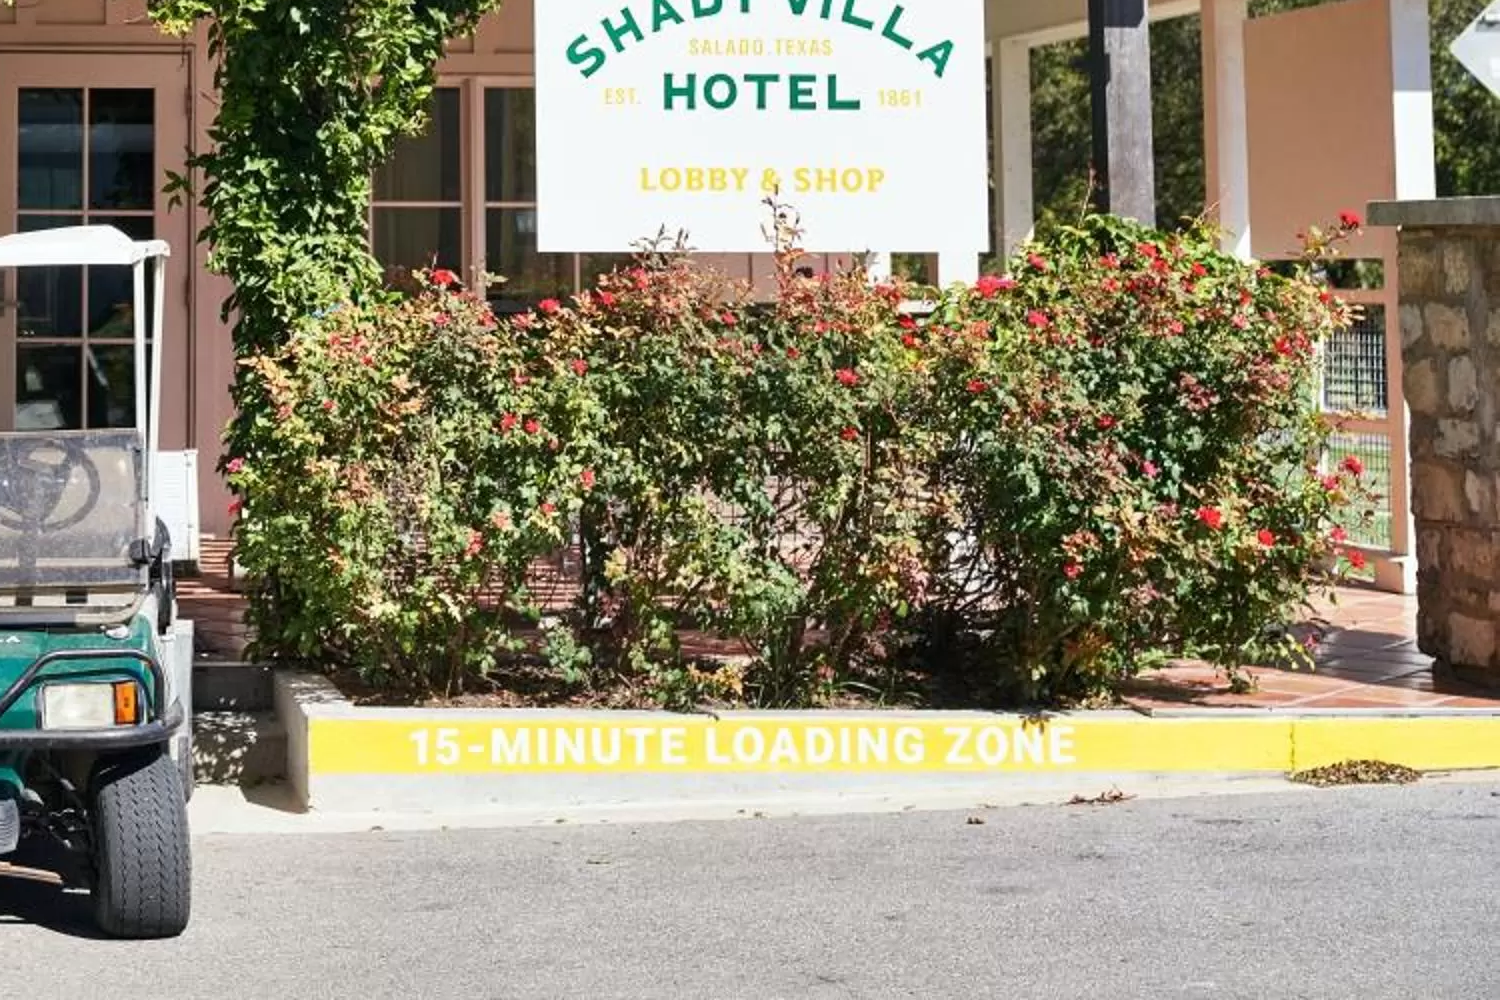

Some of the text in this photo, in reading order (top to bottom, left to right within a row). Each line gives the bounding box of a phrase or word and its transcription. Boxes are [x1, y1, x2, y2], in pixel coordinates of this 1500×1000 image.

[775, 39, 833, 56] TEXAS
[604, 73, 922, 110] EST. HOTEL 1861
[640, 167, 885, 193] LOBBY & SHOP
[409, 725, 1076, 765] 15-MINUTE LOADING ZONE
